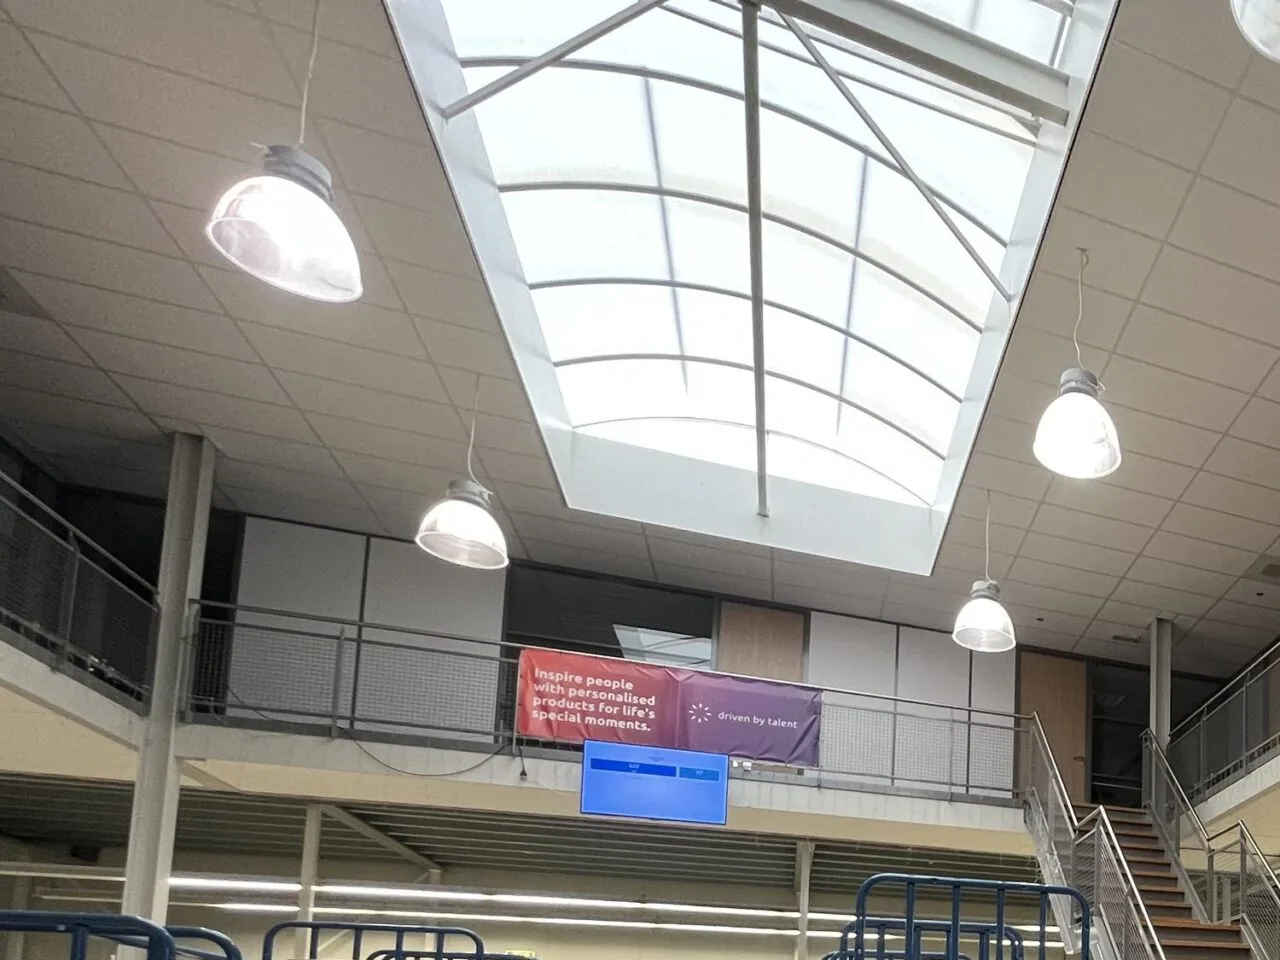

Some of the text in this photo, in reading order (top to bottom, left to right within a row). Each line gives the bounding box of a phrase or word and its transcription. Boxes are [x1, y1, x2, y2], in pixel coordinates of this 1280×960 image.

[534, 668, 634, 690] Inspire people
[533, 682, 656, 706] with personalised
[532, 696, 656, 719] products for life's
[531, 710, 652, 731] special moments.
[718, 711, 798, 729] driven by talent
